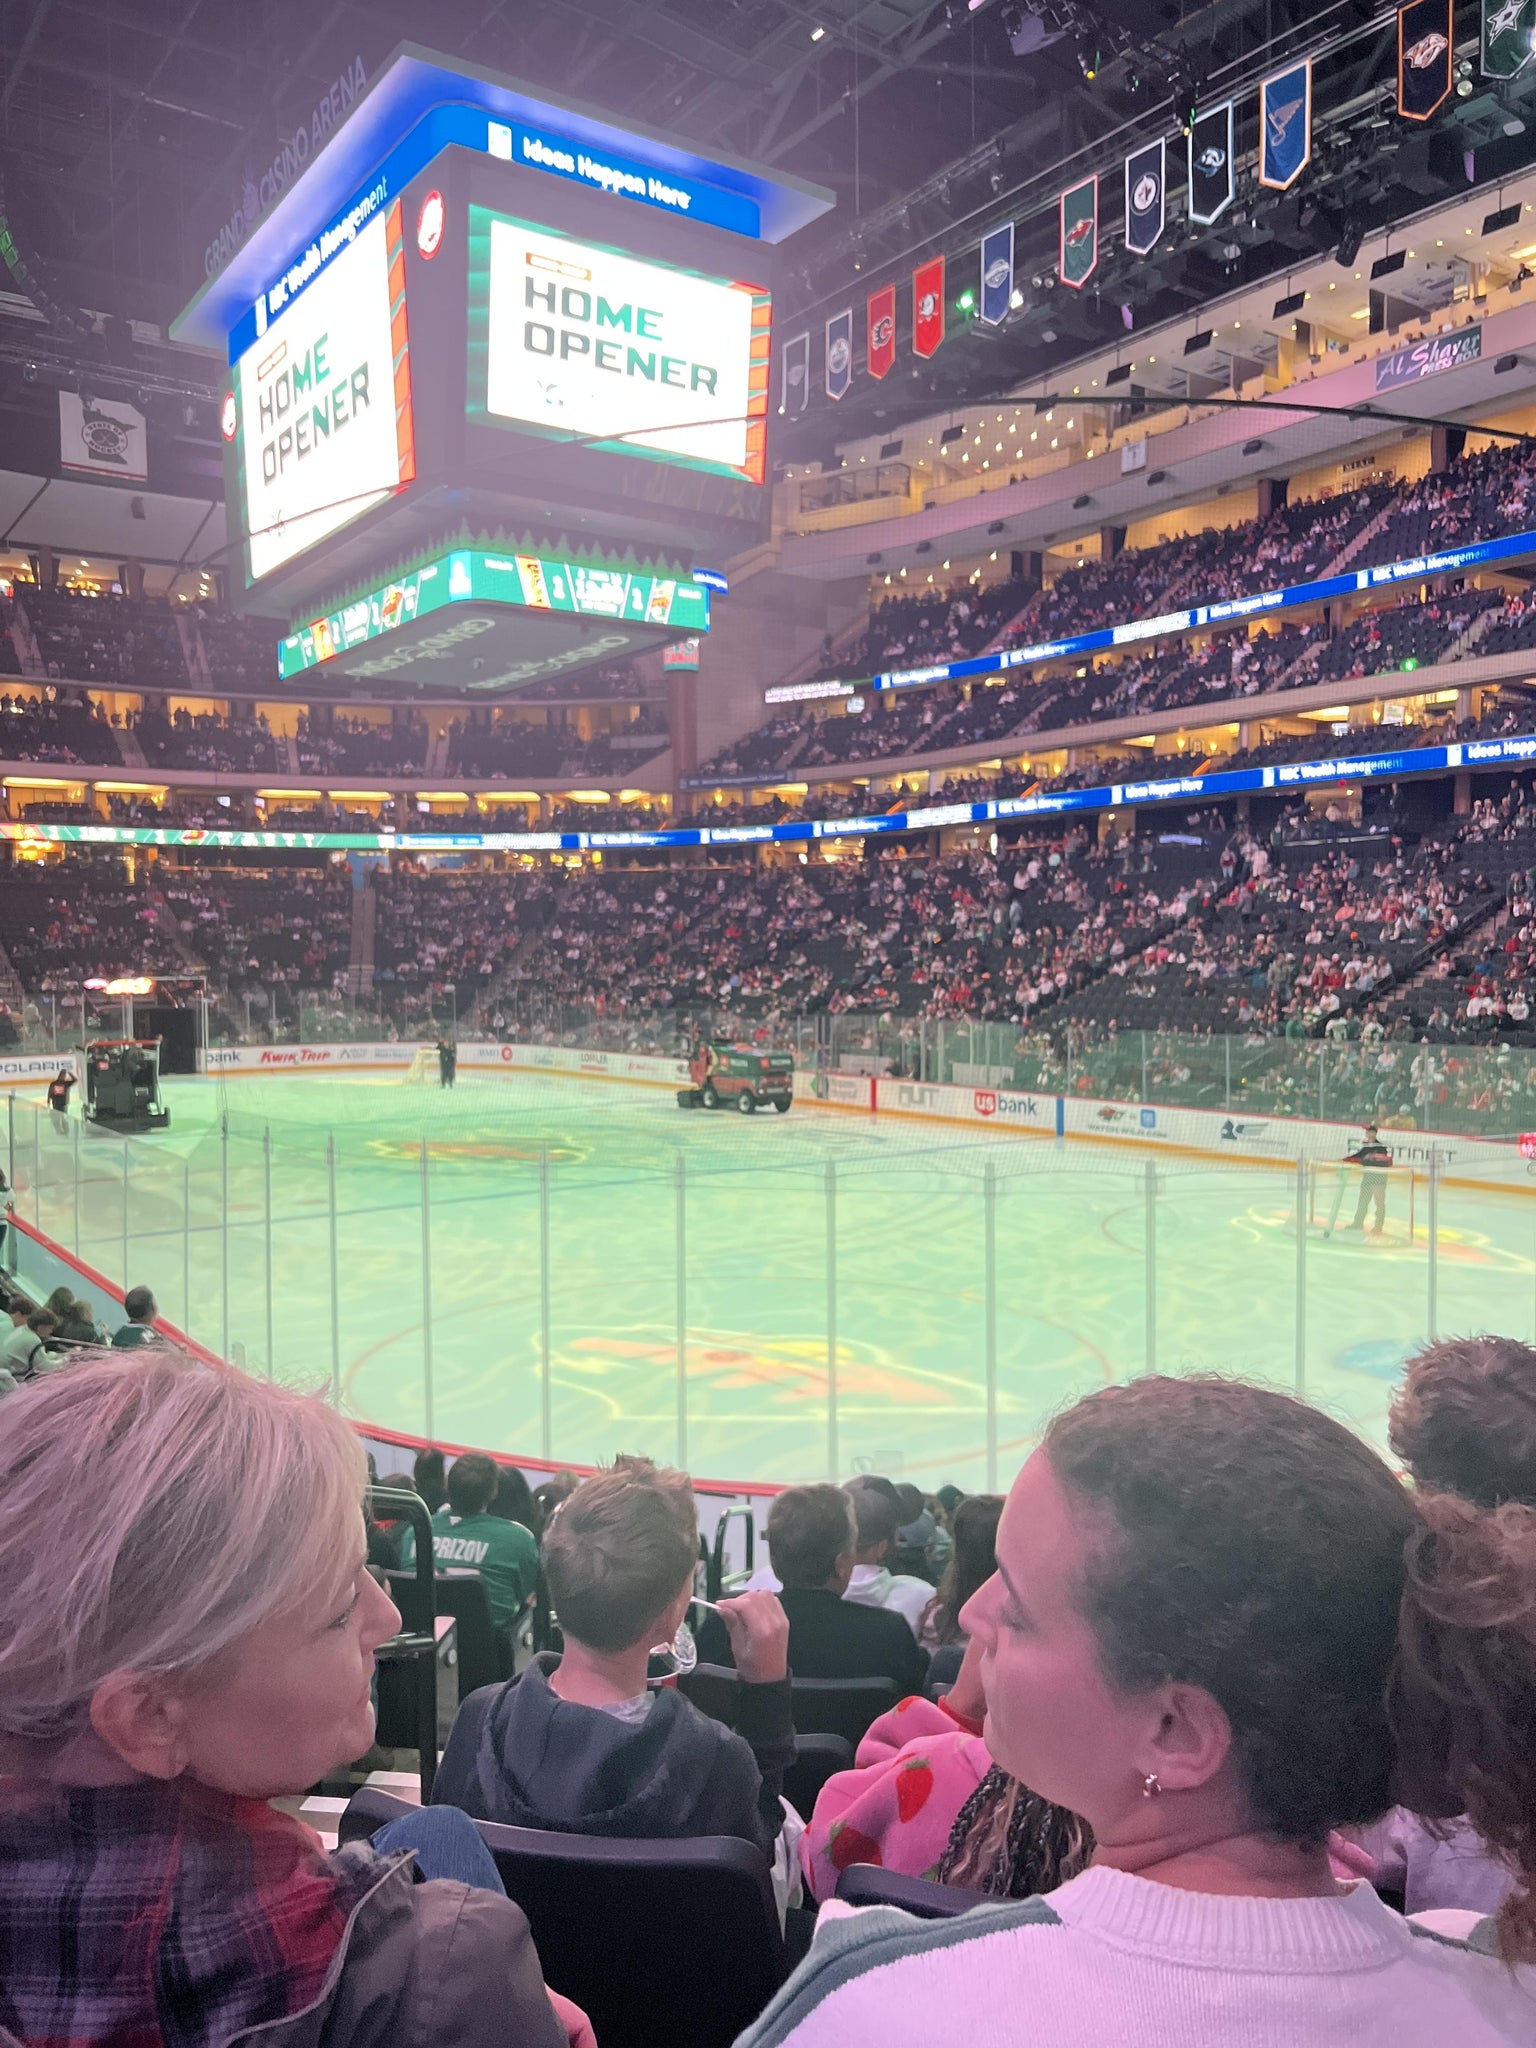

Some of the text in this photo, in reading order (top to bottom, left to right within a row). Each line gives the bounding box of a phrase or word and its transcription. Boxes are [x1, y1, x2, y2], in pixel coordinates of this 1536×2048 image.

[204, 55, 368, 277] GRAND CASINO ARENA
[523, 136, 692, 210] Ideas Happen Here
[525, 276, 664, 341] HOME
[524, 321, 718, 396] OPENER
[1376, 333, 1481, 386] Al Shaver
[1420, 346, 1481, 377] PRESS BOX
[259, 332, 330, 434] HOME
[263, 361, 370, 486] OPENER
[1427, 547, 1490, 569] Management
[1468, 743, 1502, 759] Ideas
[1300, 762, 1336, 778] Wealth
[1336, 758, 1403, 777] Management
[0, 1060, 73, 1073] OLARIS
[998, 1093, 1038, 1117] bank
[1347, 1138, 1458, 1164] FTINET
[409, 1536, 489, 1564] PRIZOV
